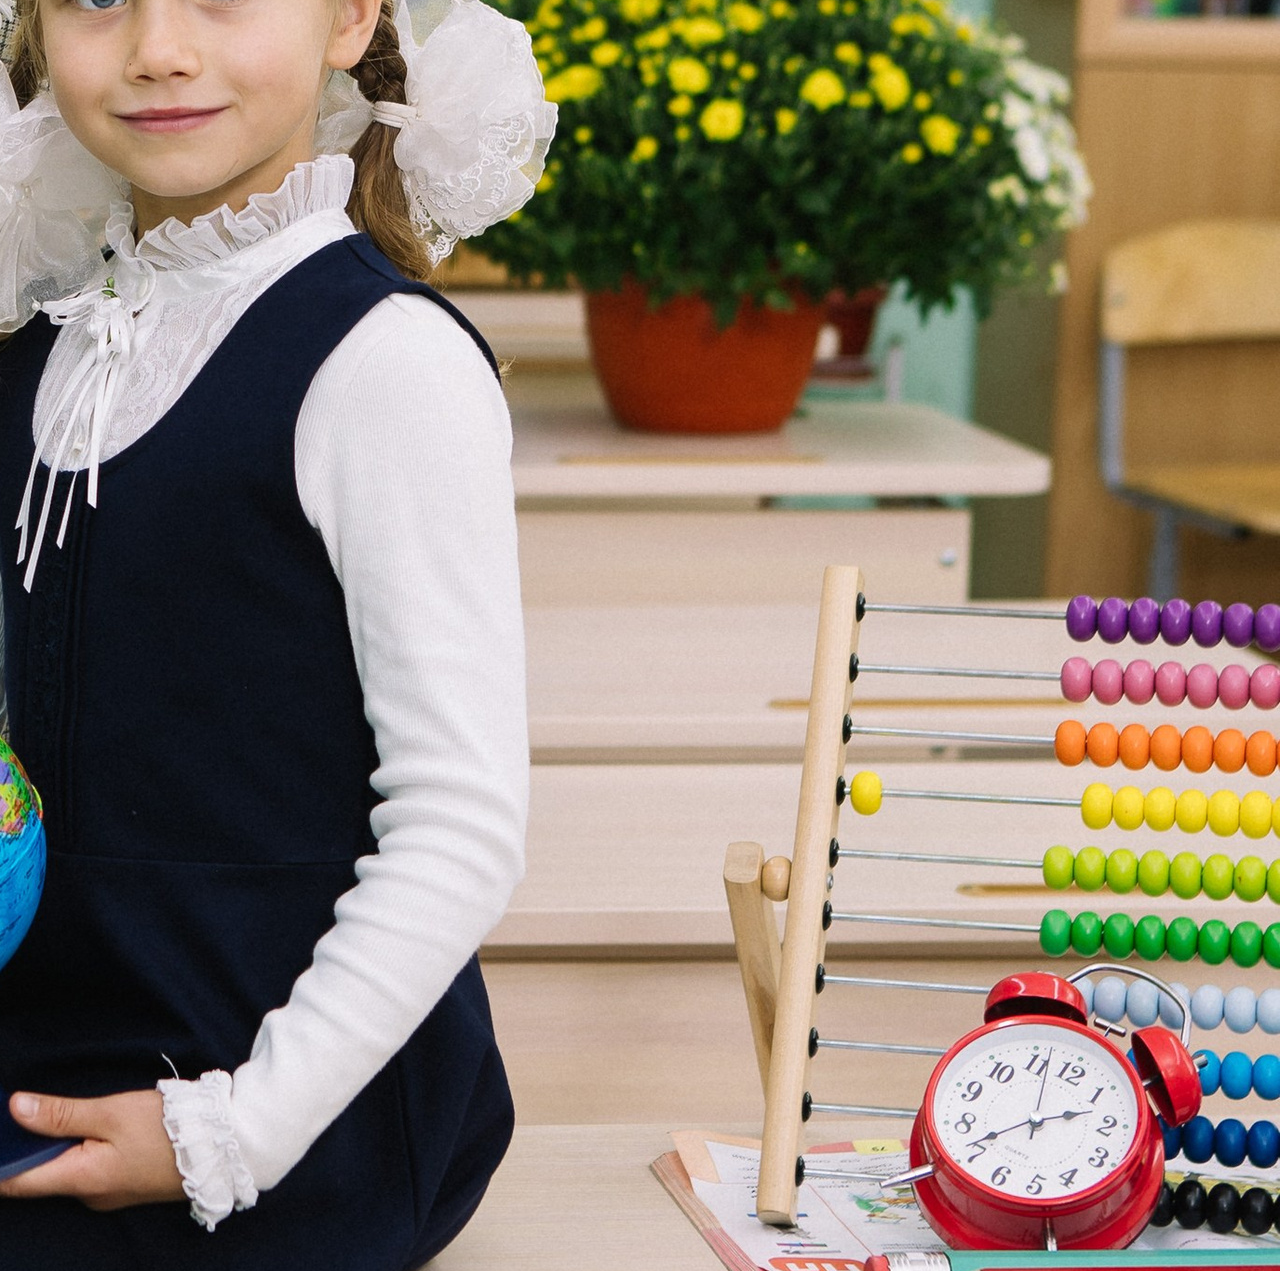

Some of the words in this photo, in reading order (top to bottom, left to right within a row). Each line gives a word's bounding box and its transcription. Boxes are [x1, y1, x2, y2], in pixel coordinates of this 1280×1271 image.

[985, 1061, 1015, 1084] 10
[1023, 1053, 1049, 1077] 11
[1055, 1061, 1086, 1087] 12
[961, 1081, 983, 1102] 9
[1087, 1087, 1104, 1105] 1
[954, 1112, 977, 1134] 8
[1095, 1115, 1118, 1137] 2
[967, 1140, 987, 1164] 7
[1004, 1144, 1030, 1161] QUARTZ
[1087, 1146, 1109, 1168] 3
[991, 1166, 1012, 1186] 6
[1025, 1173, 1048, 1195] 5
[1058, 1168, 1079, 1189] 4
